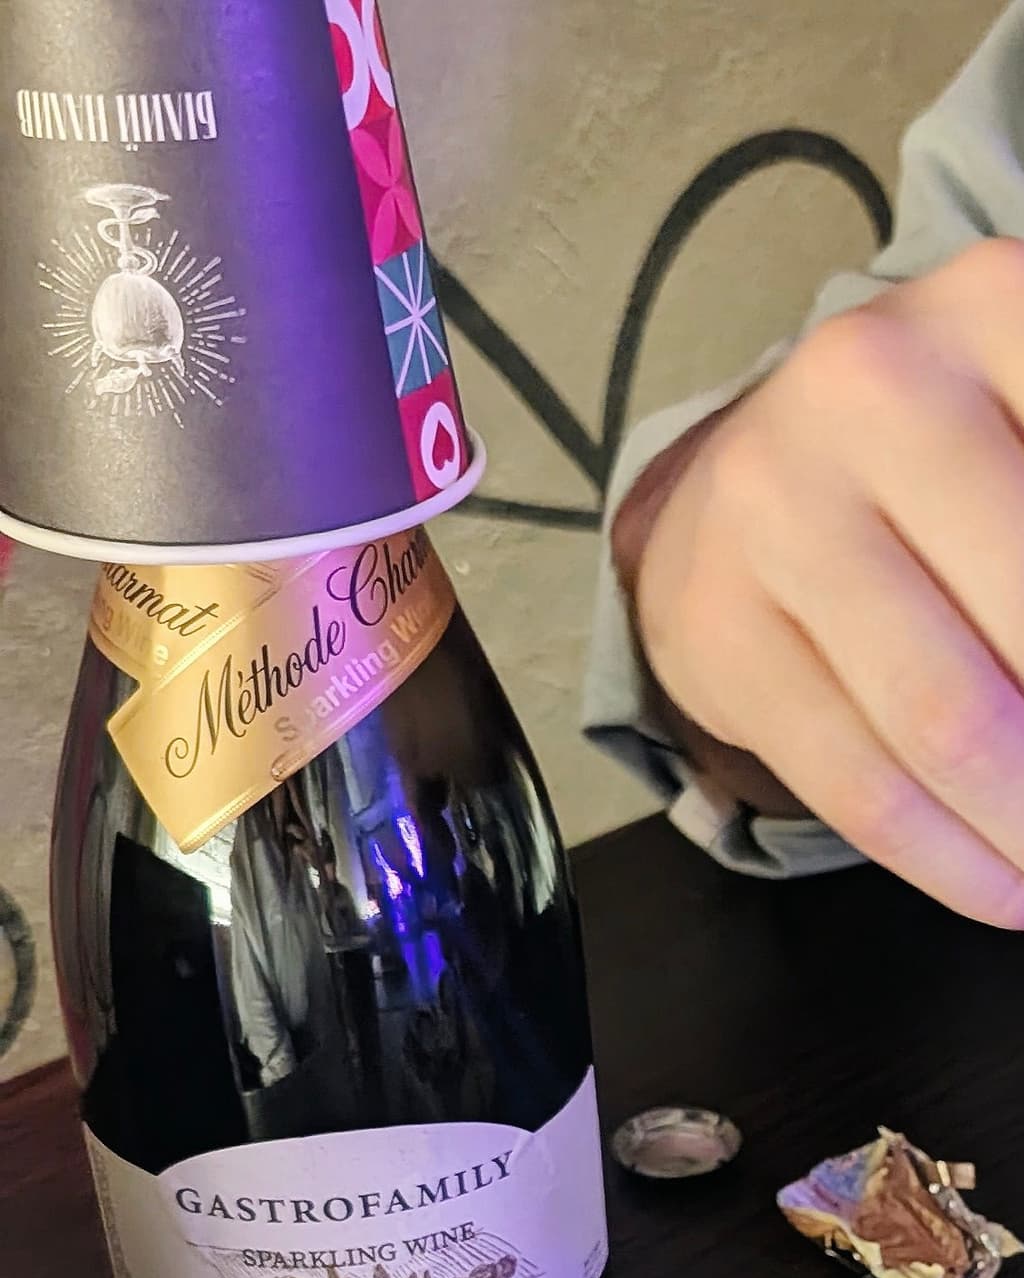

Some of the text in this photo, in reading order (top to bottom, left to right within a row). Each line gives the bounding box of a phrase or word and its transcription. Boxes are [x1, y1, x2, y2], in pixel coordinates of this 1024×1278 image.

[16, 89, 218, 152] БІЛИЙ НАЛИВ
[164, 604, 346, 779] Méthode
[274, 640, 402, 743] Sarkling
[175, 1150, 514, 1224] GASTROFAMILY
[242, 1221, 478, 1270] SPARKLING WINE
